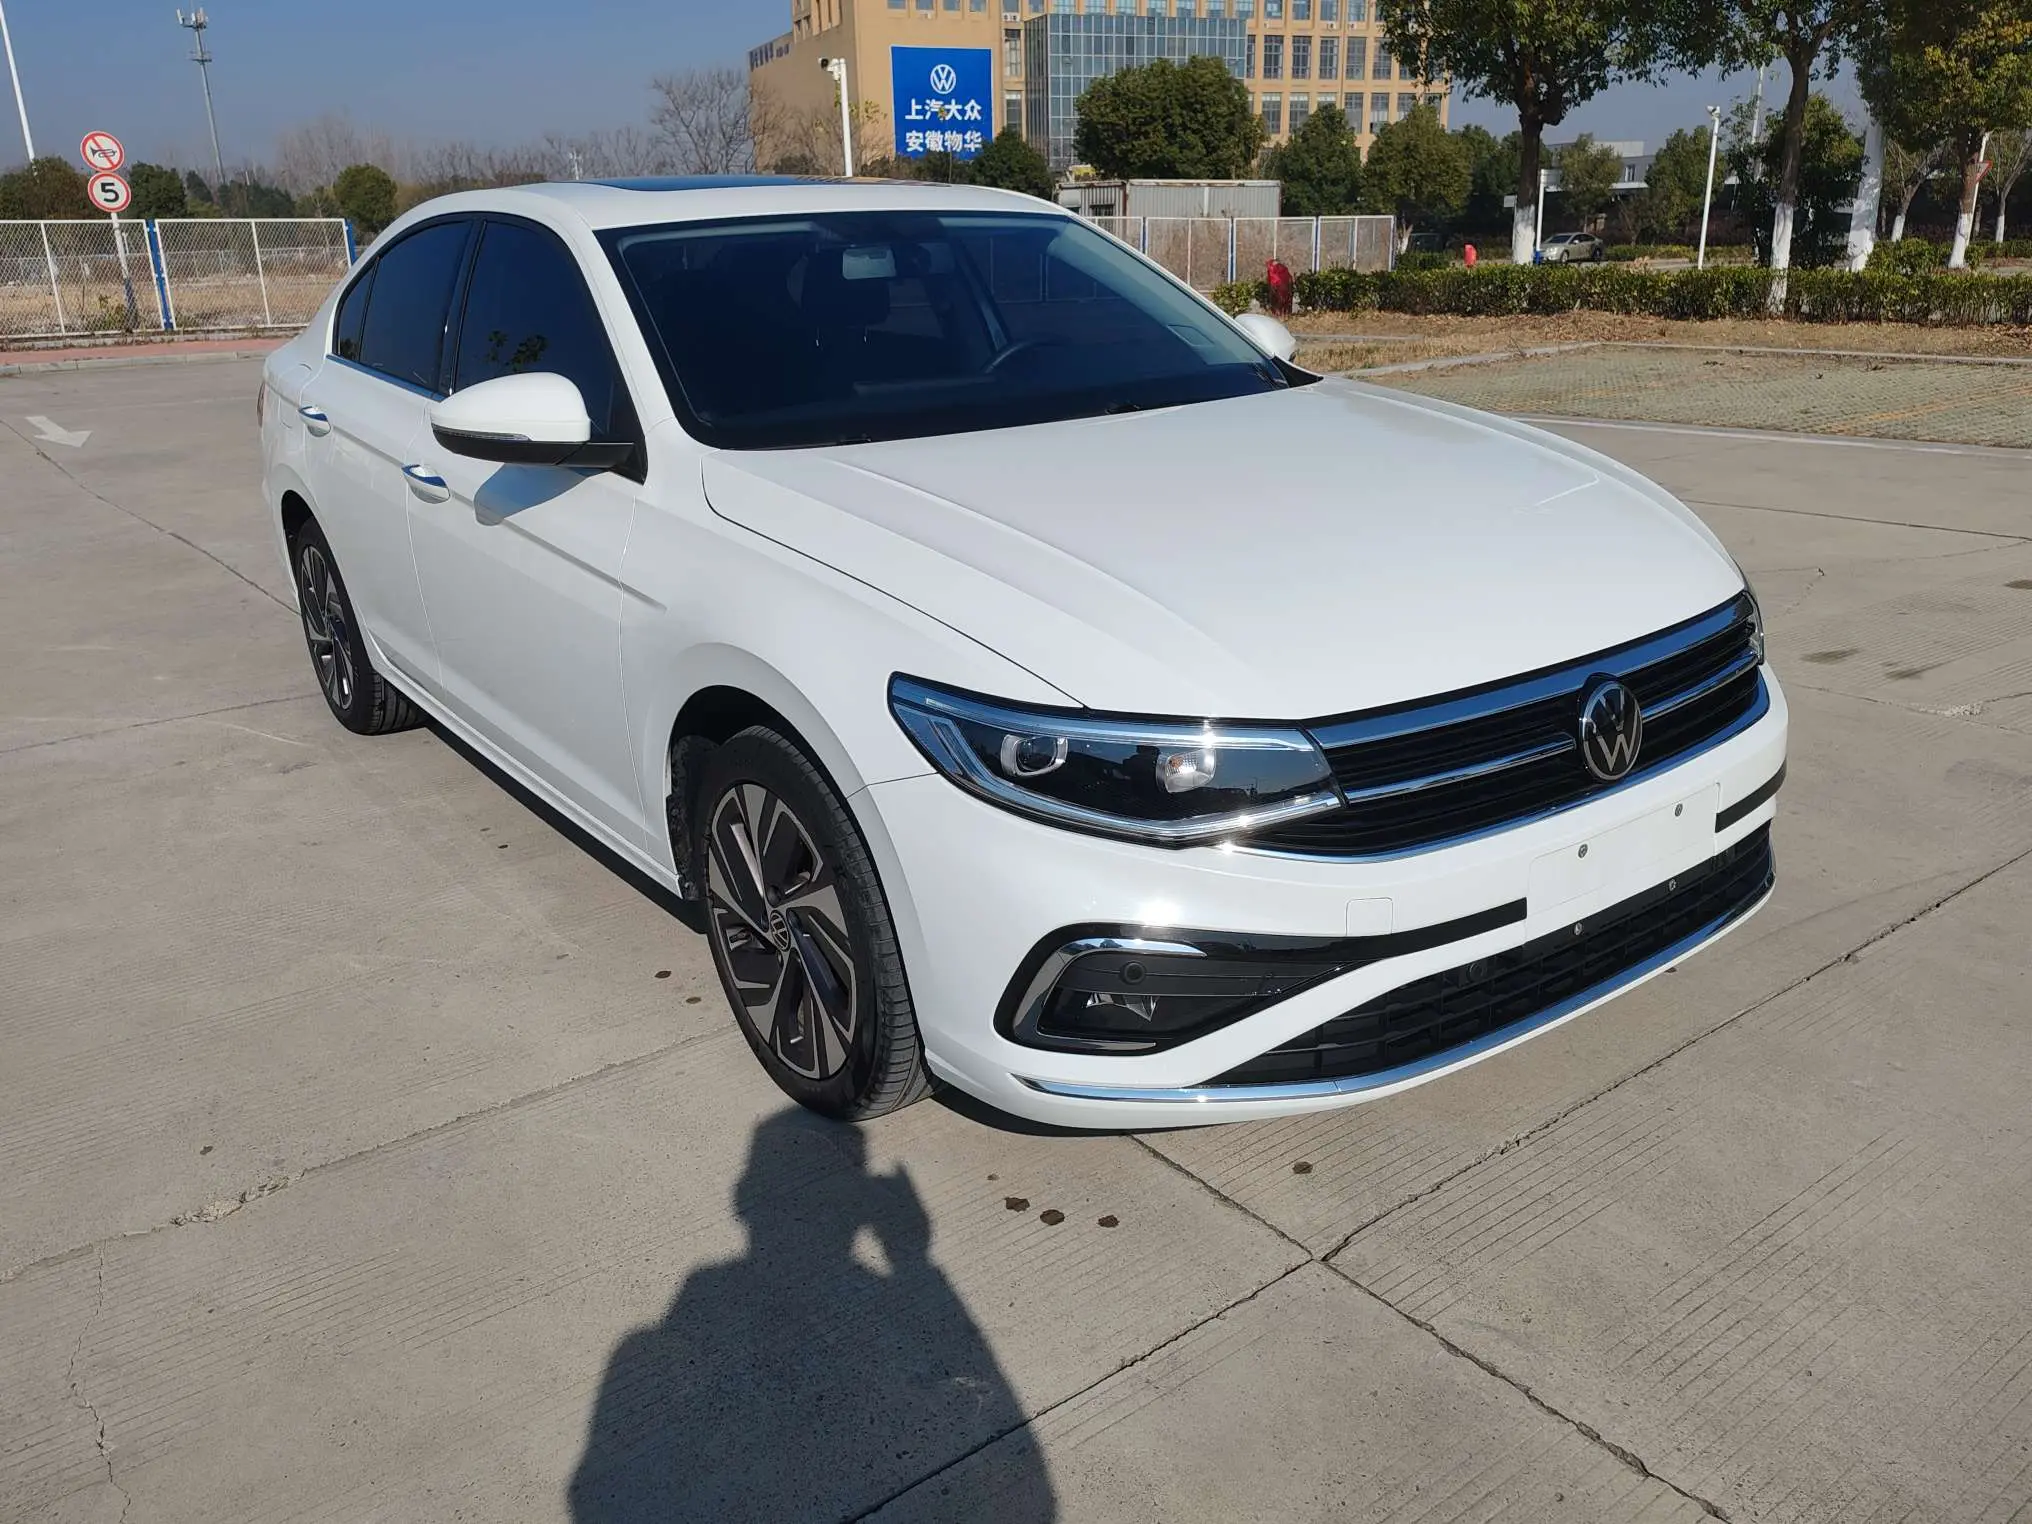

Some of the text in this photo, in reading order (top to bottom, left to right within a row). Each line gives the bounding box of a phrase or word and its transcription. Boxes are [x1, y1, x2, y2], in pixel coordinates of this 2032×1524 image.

[905, 98, 982, 120] 上汽大众
[905, 130, 982, 152] 安徽物华
[100, 182, 120, 203] 5
